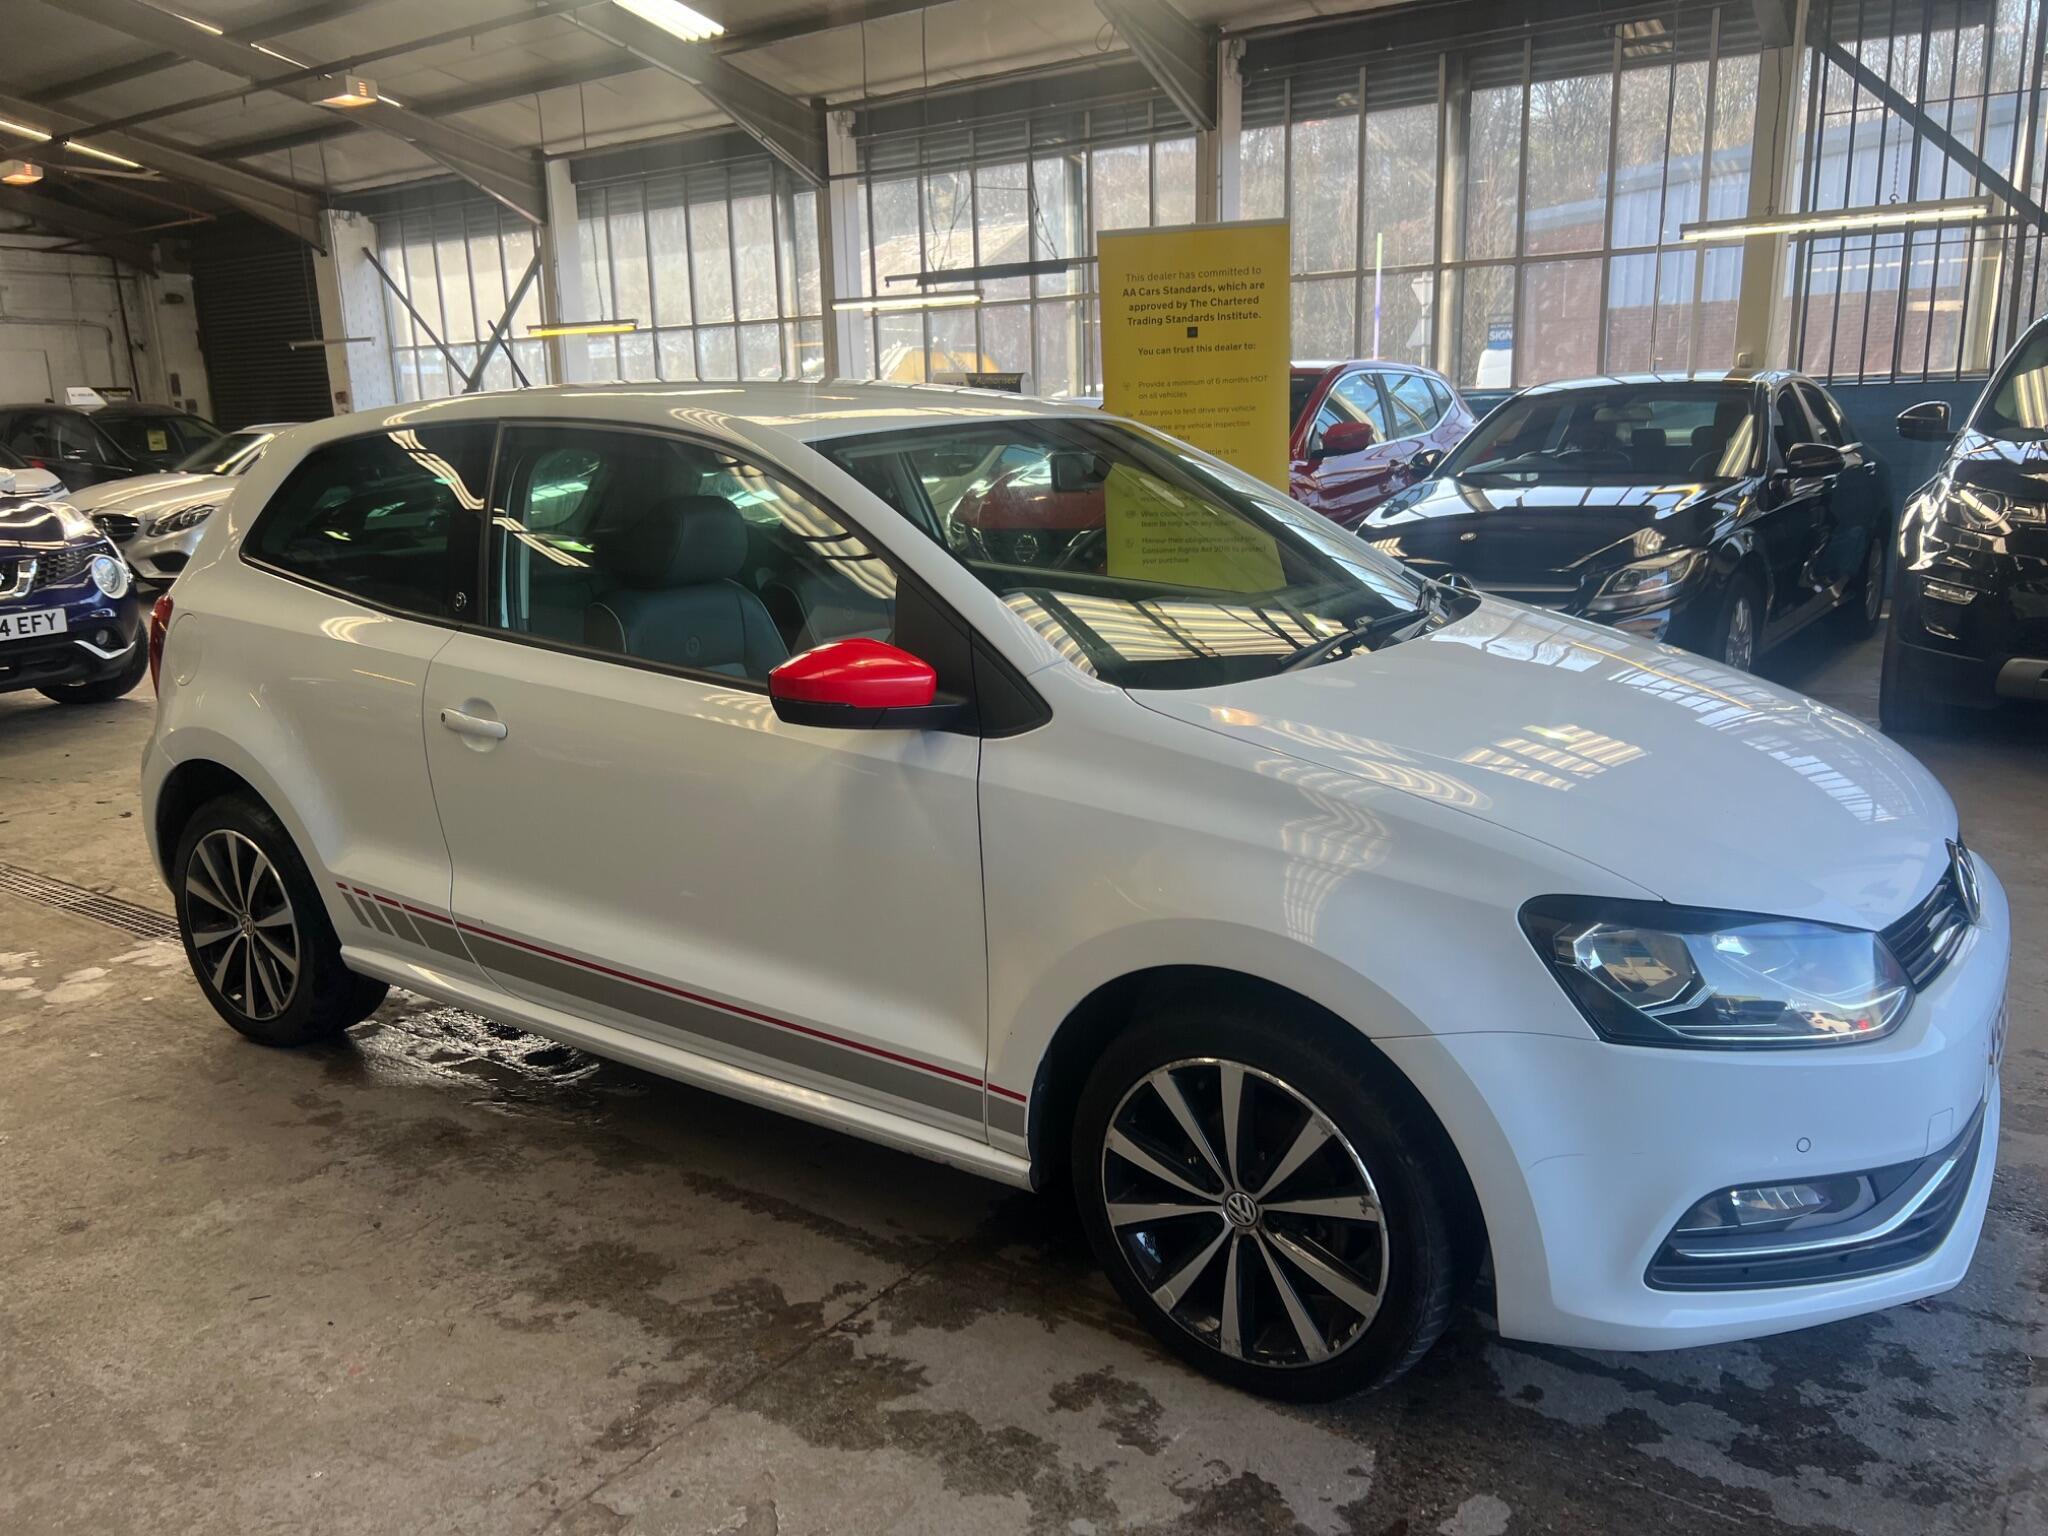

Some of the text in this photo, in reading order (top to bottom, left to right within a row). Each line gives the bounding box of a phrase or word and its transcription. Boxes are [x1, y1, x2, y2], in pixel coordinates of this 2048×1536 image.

[1126, 266, 1262, 282] This dealer has committed to
[1122, 281, 1265, 297] AA Cars Standards, which are
[1128, 296, 1259, 313] approved by The Chartered
[1127, 311, 1262, 327] Trading Standards Institute.
[1137, 347, 1154, 356] You
[1173, 346, 1194, 354] trust
[1196, 344, 1213, 353] this
[1214, 343, 1243, 352] dealer
[1244, 342, 1256, 351] to:
[1138, 380, 1165, 388] Provide
[1172, 379, 1205, 387] minimum
[1222, 376, 1249, 384] months
[1198, 406, 1216, 414] drive
[1214, 420, 1251, 429] inspection
[16, 612, 56, 635] EFY
